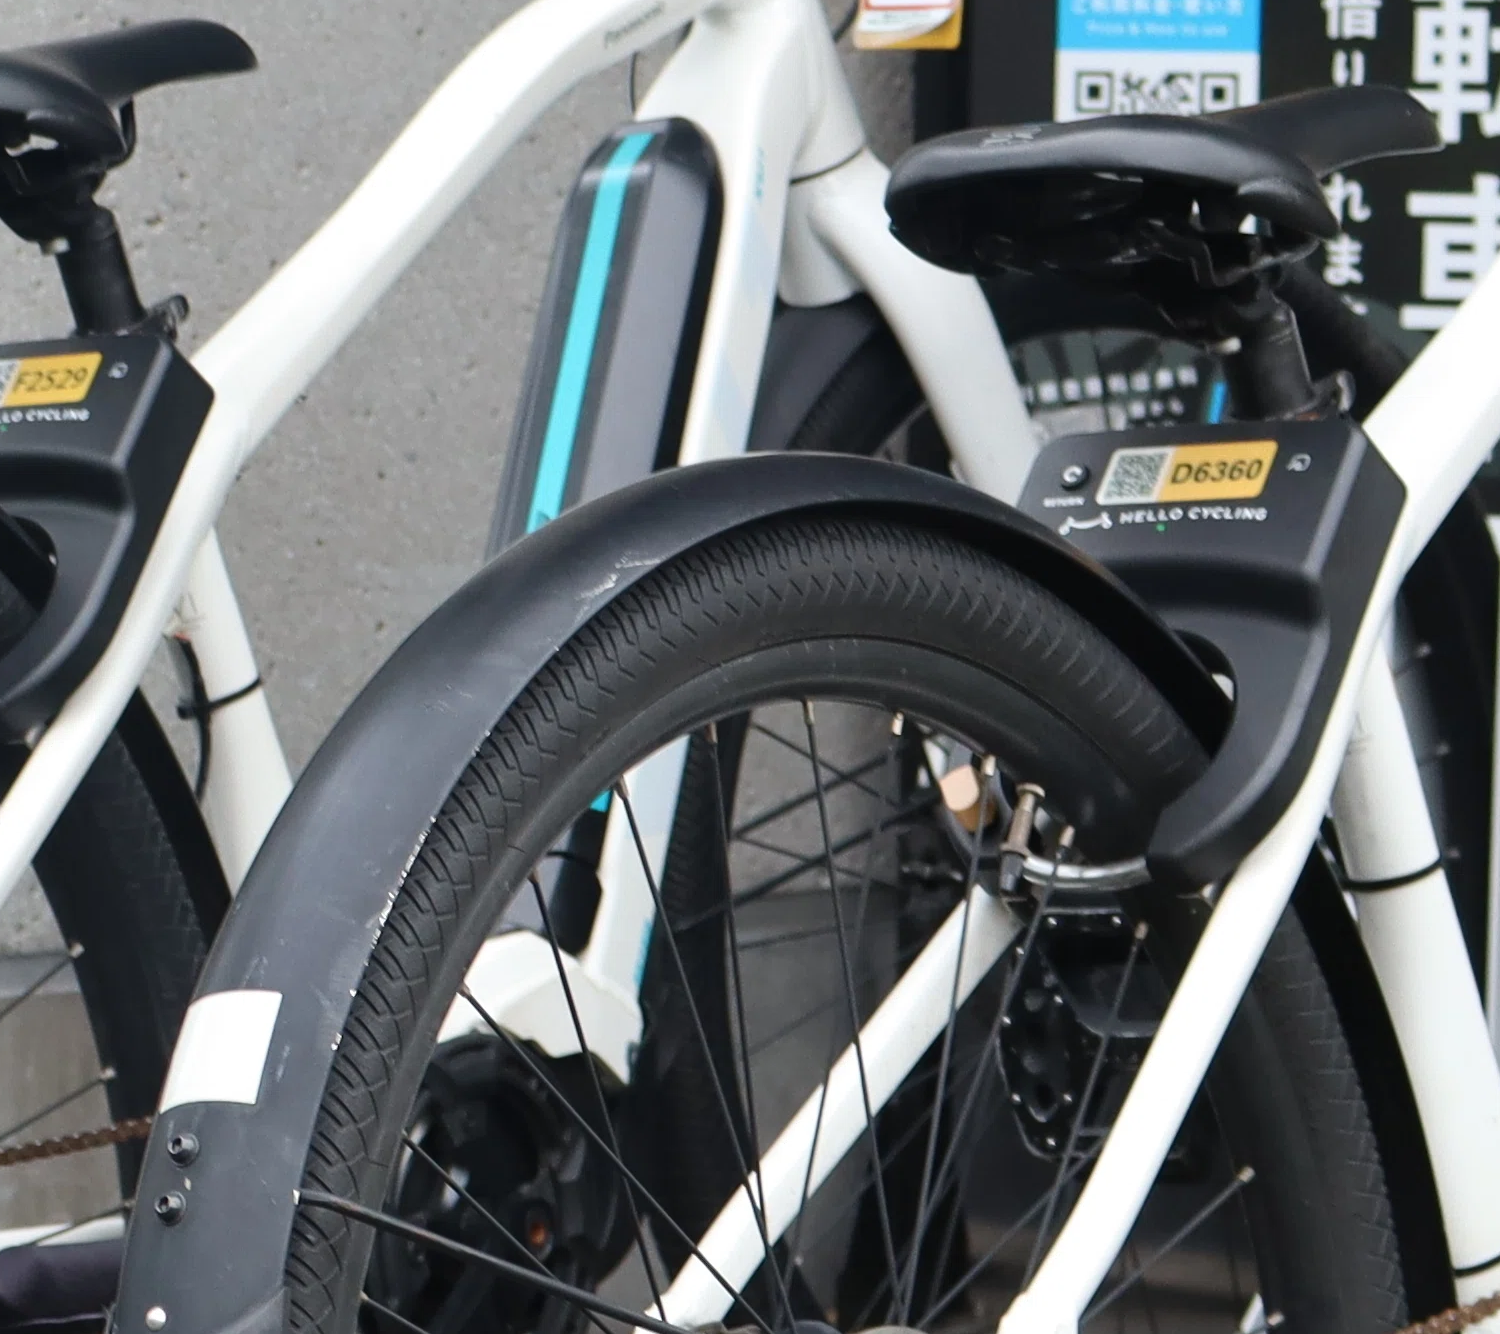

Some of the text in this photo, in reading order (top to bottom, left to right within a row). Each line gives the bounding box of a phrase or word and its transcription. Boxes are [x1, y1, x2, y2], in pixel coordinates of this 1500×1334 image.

[25, 408, 91, 423] CYCLING
[1171, 459, 1263, 485] D6360
[1119, 506, 1268, 526] HELLO CYCLING
